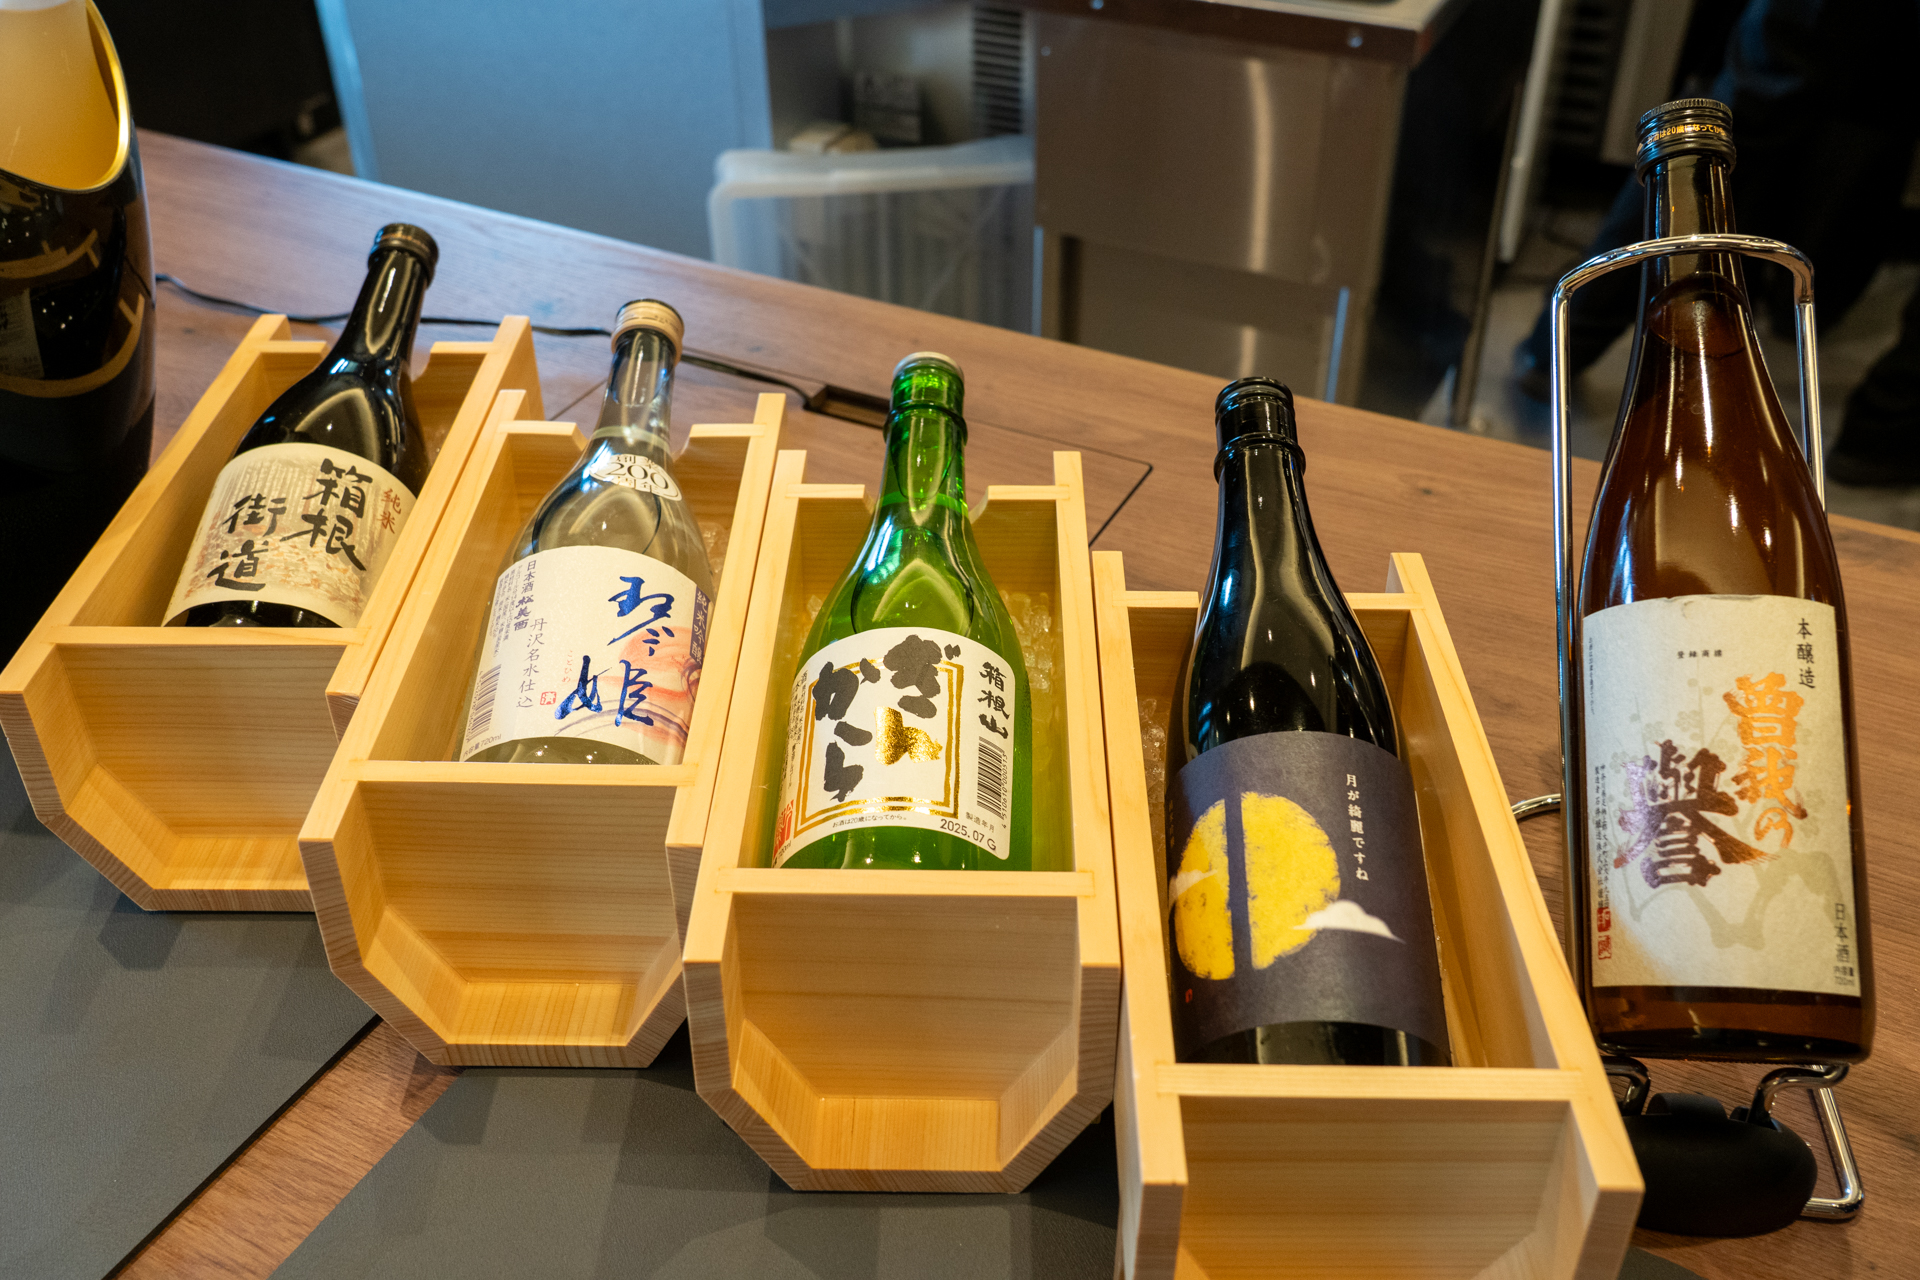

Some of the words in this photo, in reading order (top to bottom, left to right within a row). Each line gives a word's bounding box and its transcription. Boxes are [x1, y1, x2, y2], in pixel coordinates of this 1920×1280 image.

[604, 462, 669, 490] 200
[206, 492, 287, 592] 街道
[280, 458, 373, 571] 箱根
[375, 488, 402, 535] 純米
[521, 560, 537, 594] 日本酒
[516, 617, 548, 708] 丹沢名水仕込
[1796, 617, 1816, 689] 本醸造
[977, 661, 1011, 740] 箱根山
[940, 818, 985, 843] 2025.07
[986, 838, 997, 851] G
[965, 812, 995, 833] 製造年月
[1346, 773, 1369, 881] 月が綺麗ですね
[1834, 902, 1850, 963] 日本酒
